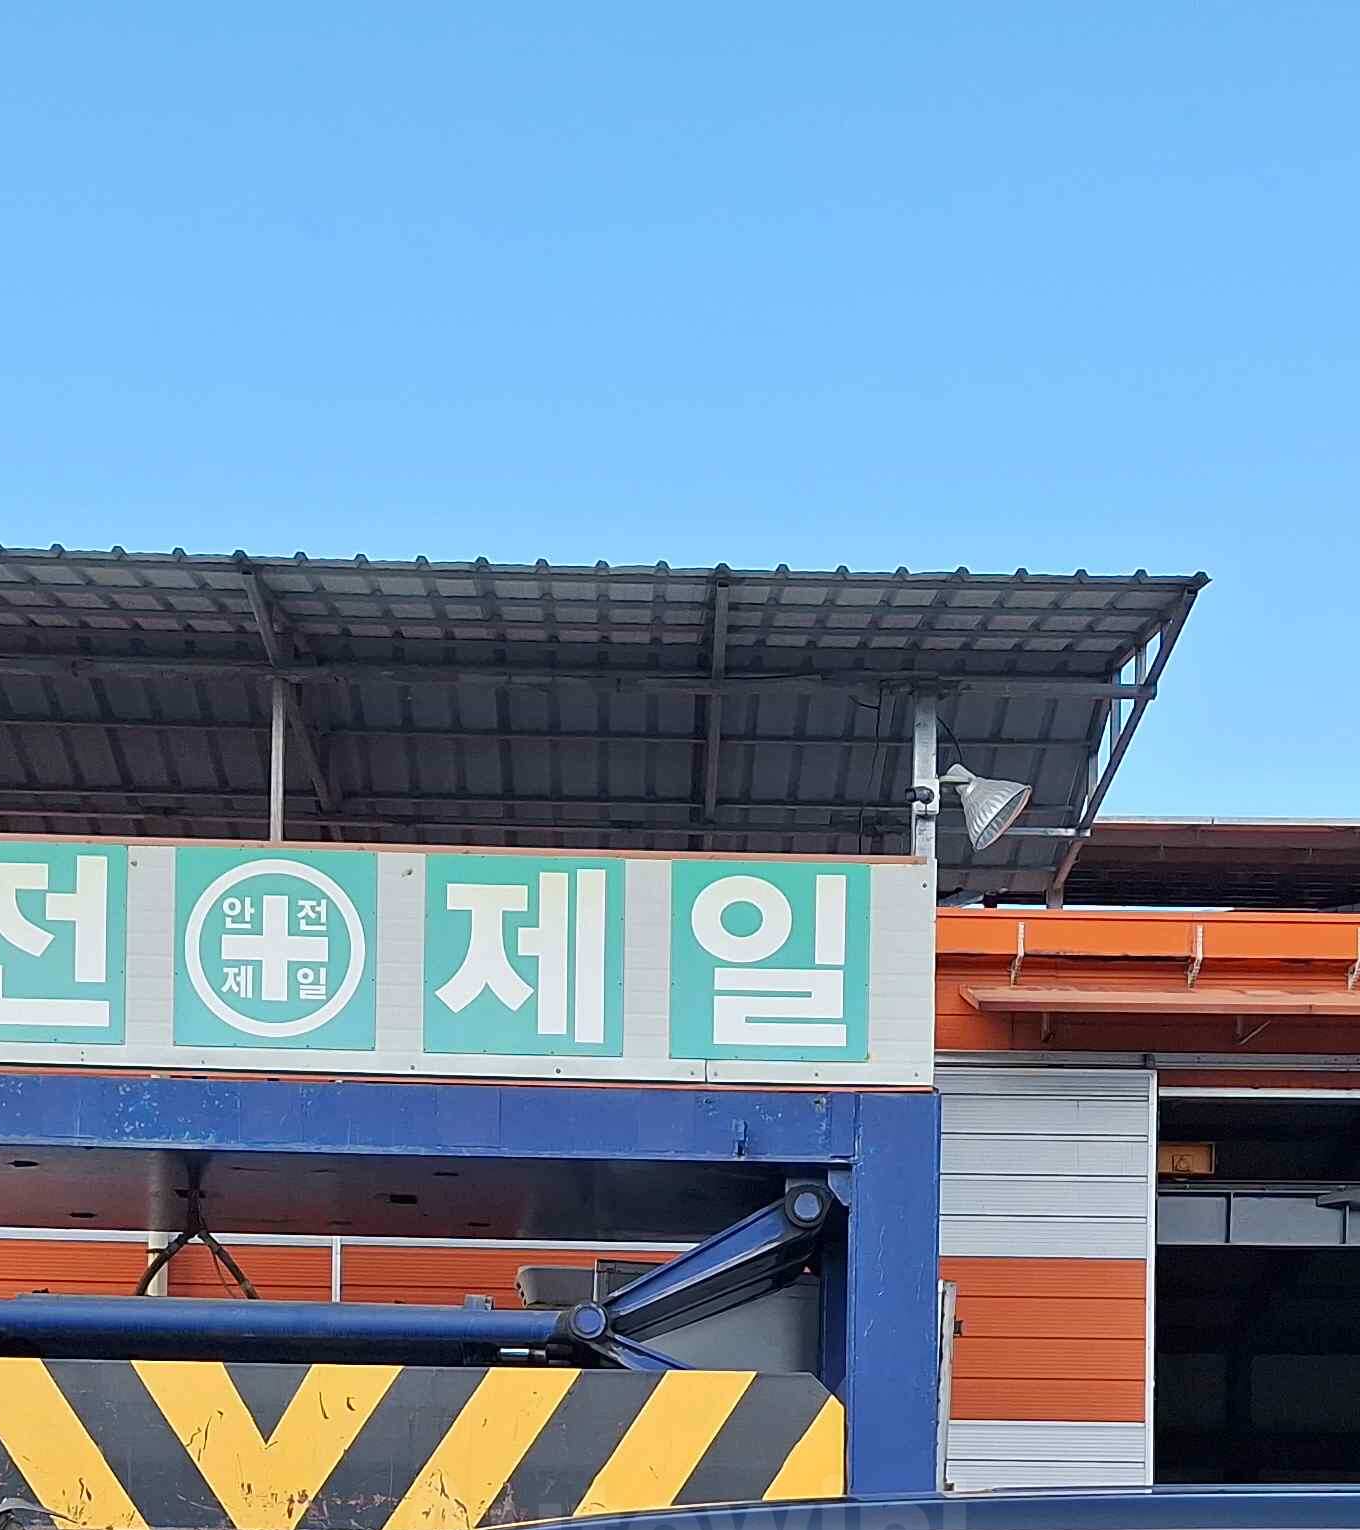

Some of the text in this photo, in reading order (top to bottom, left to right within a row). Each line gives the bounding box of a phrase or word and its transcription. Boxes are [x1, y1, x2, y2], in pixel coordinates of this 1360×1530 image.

[222, 897, 328, 931] 안 전
[435, 868, 847, 1050] 제일
[220, 965, 327, 1000] 제 일
